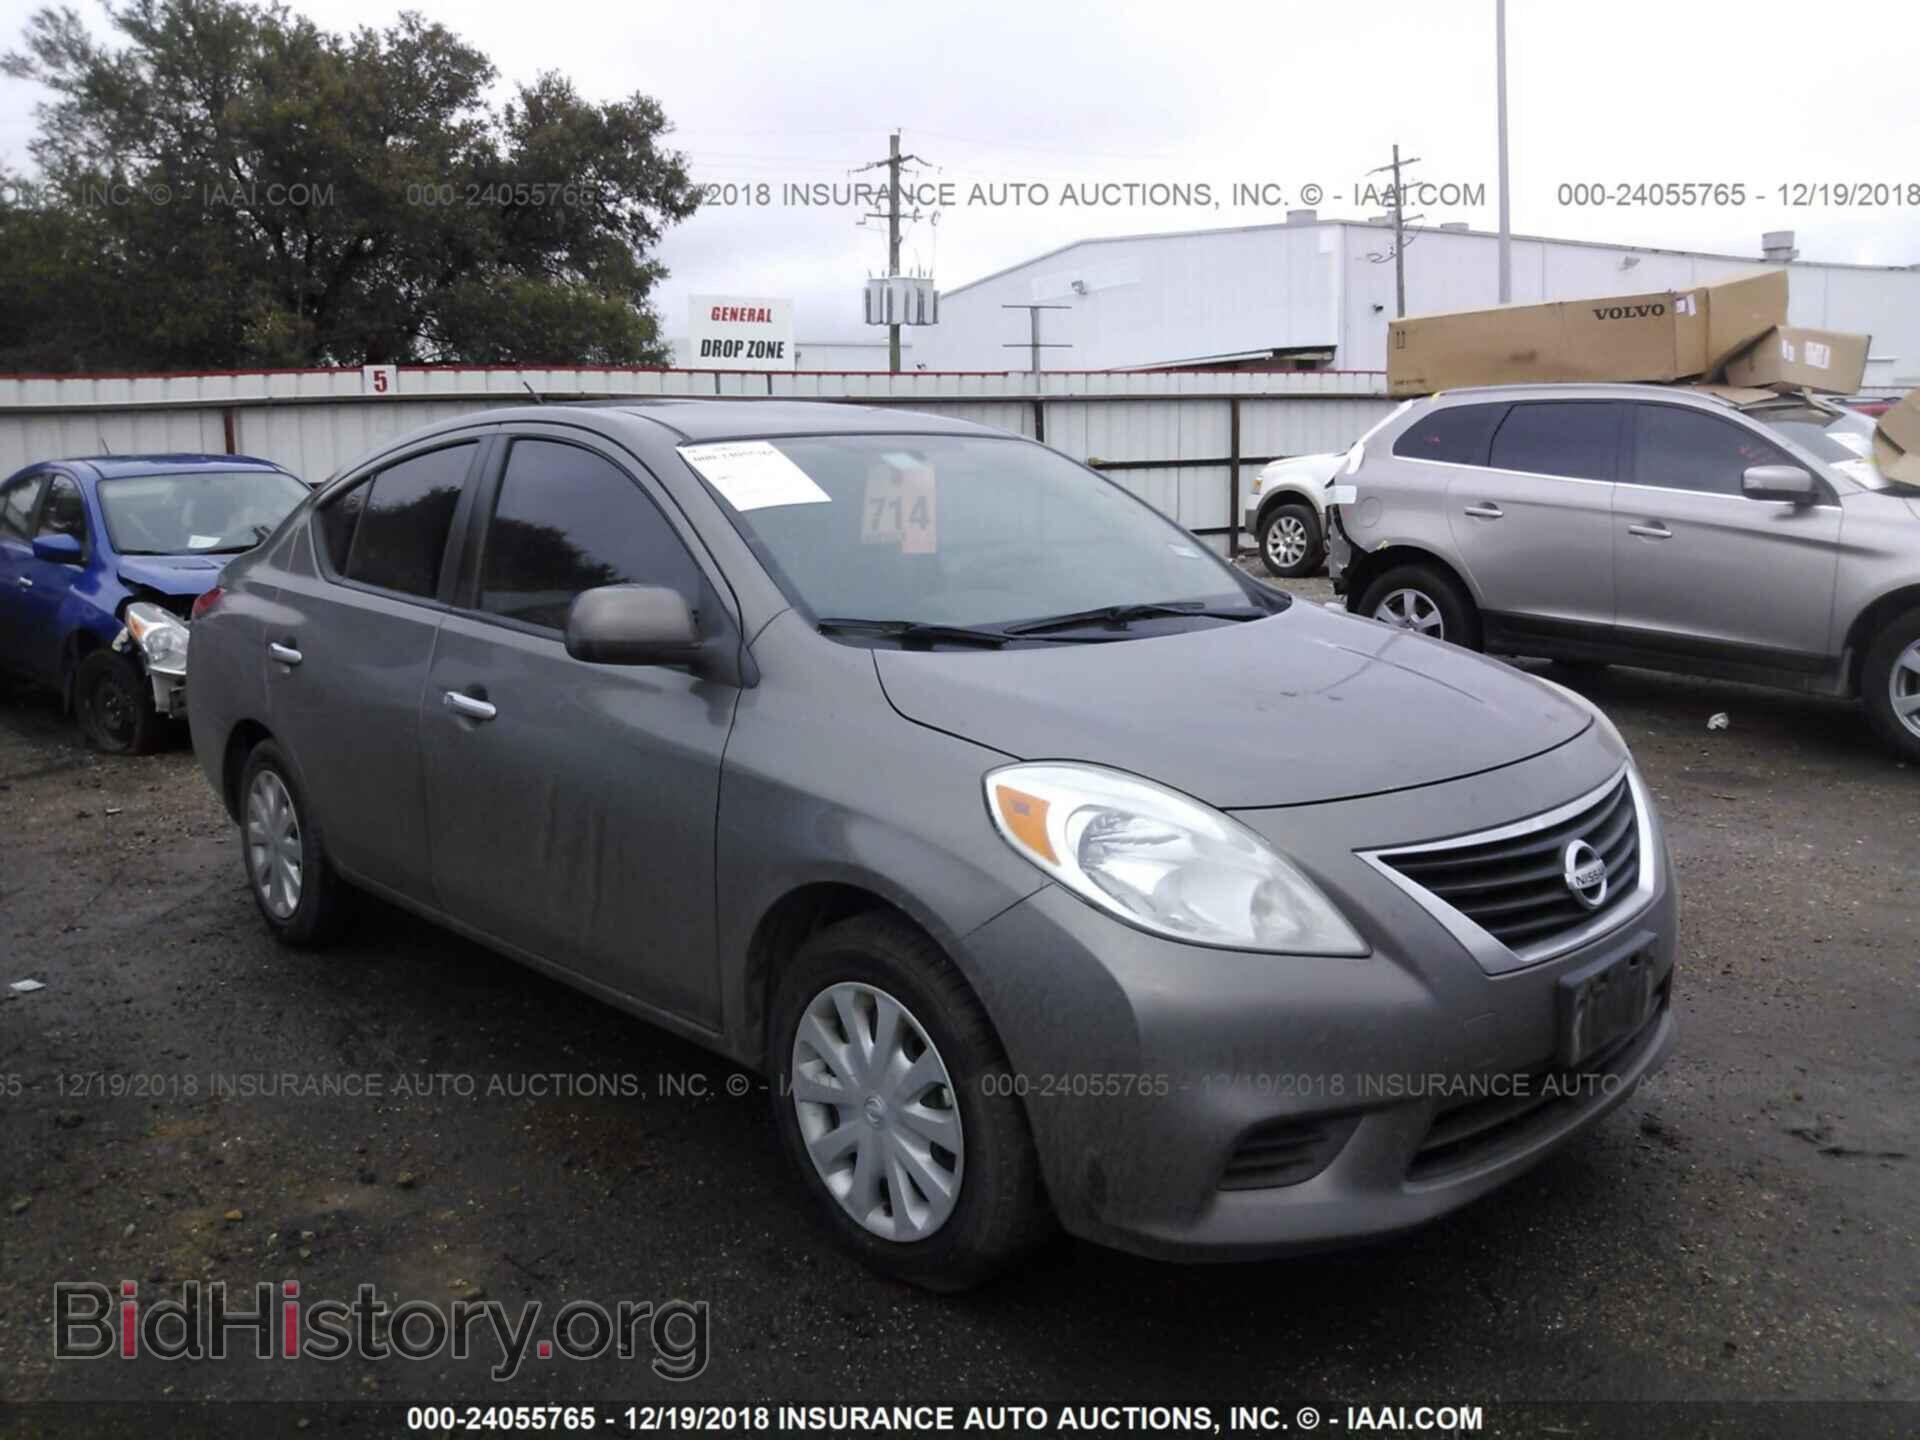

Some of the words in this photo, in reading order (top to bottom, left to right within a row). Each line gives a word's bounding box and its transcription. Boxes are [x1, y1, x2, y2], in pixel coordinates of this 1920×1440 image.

[711, 306, 773, 323] GENERAL
[1592, 303, 1665, 321] VOLVO
[700, 339, 744, 358] DROP
[746, 340, 785, 359] ZONE
[374, 370, 388, 393] 5
[868, 495, 931, 532] 714
